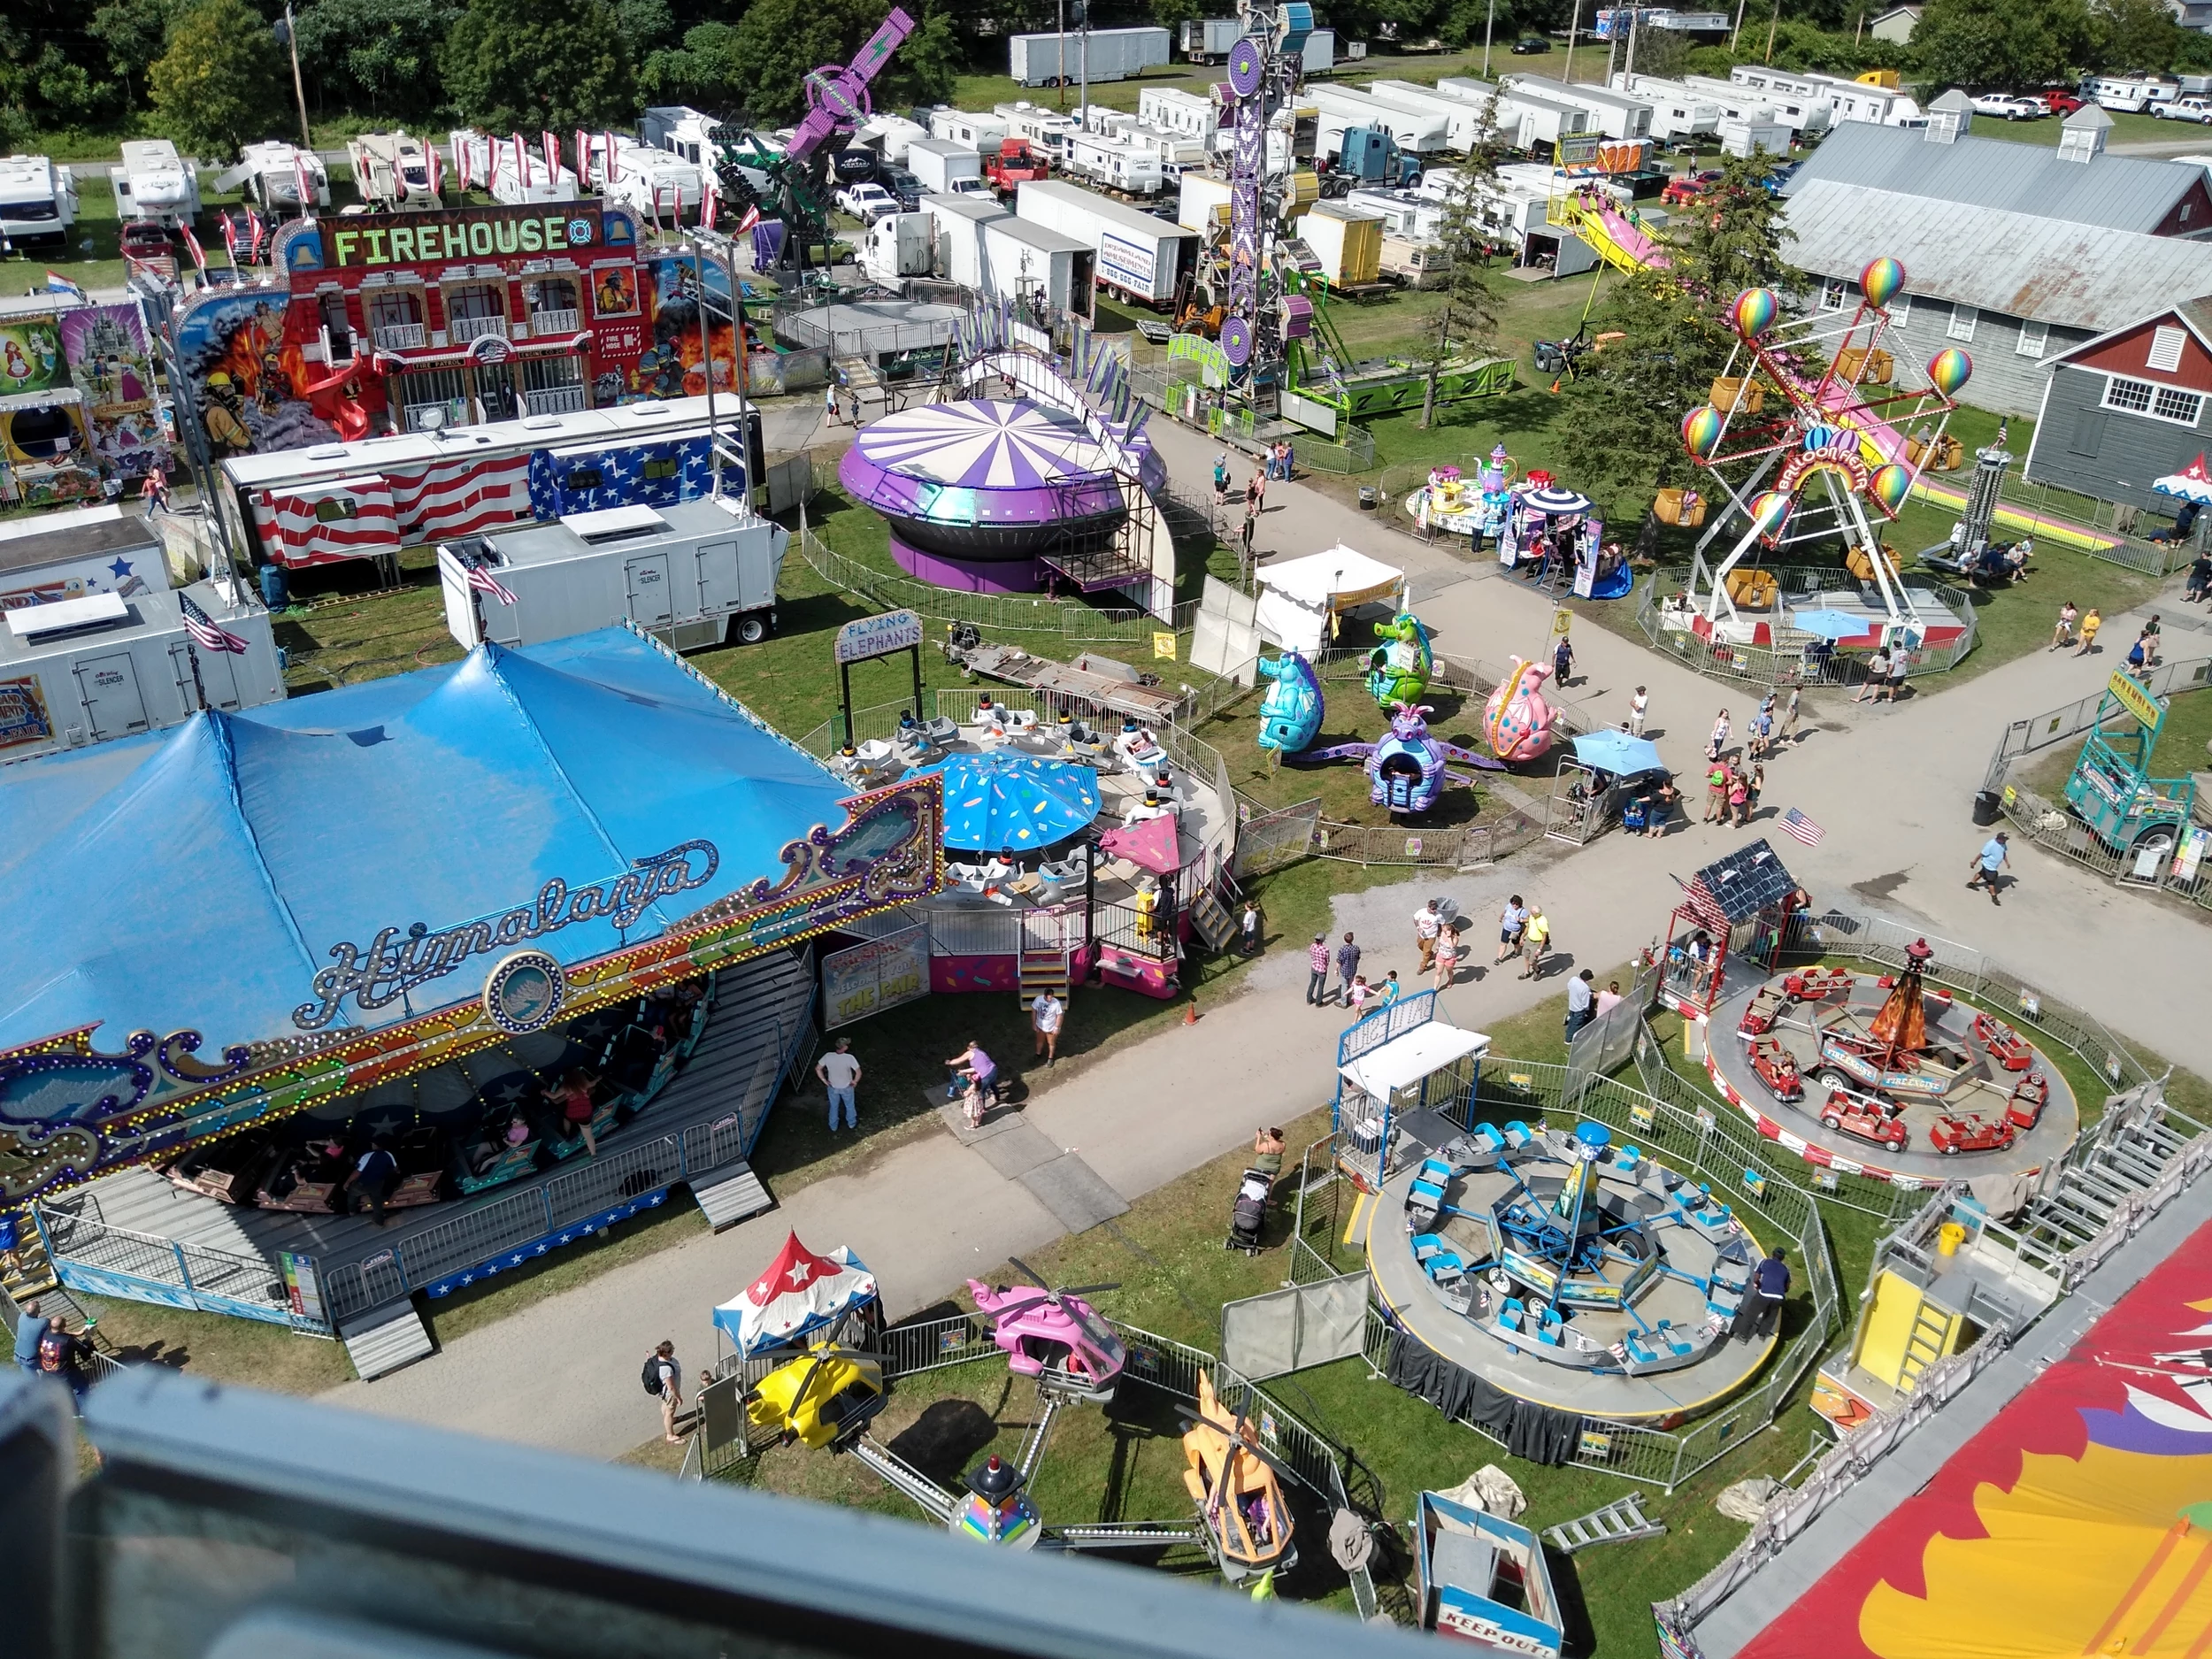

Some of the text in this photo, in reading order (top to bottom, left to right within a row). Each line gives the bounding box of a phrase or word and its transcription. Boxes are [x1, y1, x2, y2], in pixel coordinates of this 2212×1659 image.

[334, 217, 568, 266] FIREHOUSE
[1103, 250, 1151, 275] AMUSEMENTS
[1104, 242, 1151, 265] DREAMLAND
[0, 316, 22, 325] IDING
[434, 359, 462, 368] PATROL
[101, 403, 142, 413] CINDERELLA
[1356, 394, 1373, 412] Z
[1392, 388, 1409, 407] Z
[1778, 447, 1868, 492] BALLOON FIESTA
[641, 573, 661, 584] SILENCER
[847, 612, 910, 638] FLYING
[840, 626, 920, 660] ELEPHANTS
[99, 675, 124, 686] SILENCER
[292, 838, 720, 1030] Himalaya
[832, 971, 886, 996] WELCOMES
[891, 961, 910, 976] YOU
[836, 973, 919, 1018] THE FAIR
[1826, 1048, 1873, 1079] FIRE ENGINE
[1886, 1077, 1940, 1090] FIRE ENGINE
[284, 1256, 293, 1271] YES
[294, 1292, 303, 1313] SORRY
[1446, 1612, 1549, 1658] KEEP OUT!
